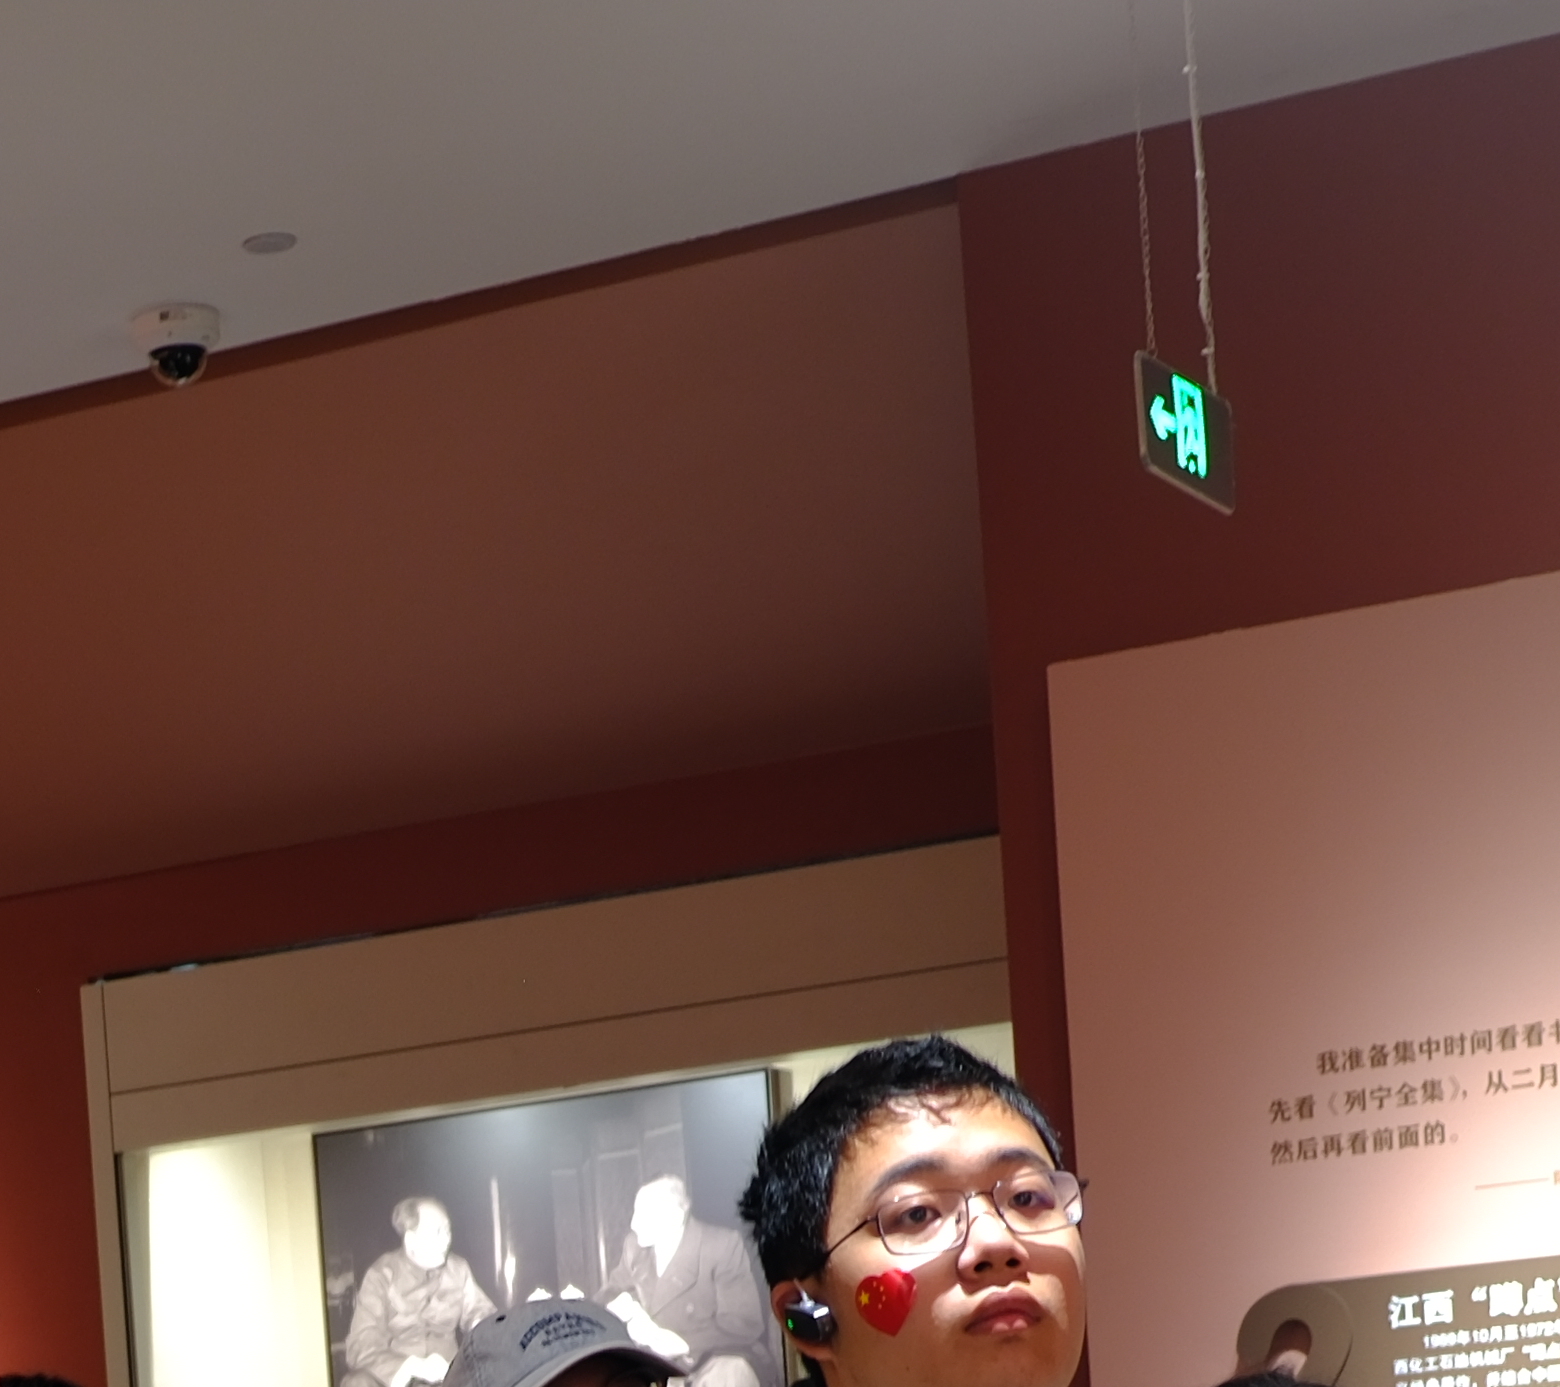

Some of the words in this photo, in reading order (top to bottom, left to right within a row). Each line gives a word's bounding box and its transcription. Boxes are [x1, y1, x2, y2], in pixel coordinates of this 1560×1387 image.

[1269, 1119, 1462, 1166] 然后再看前面的。
